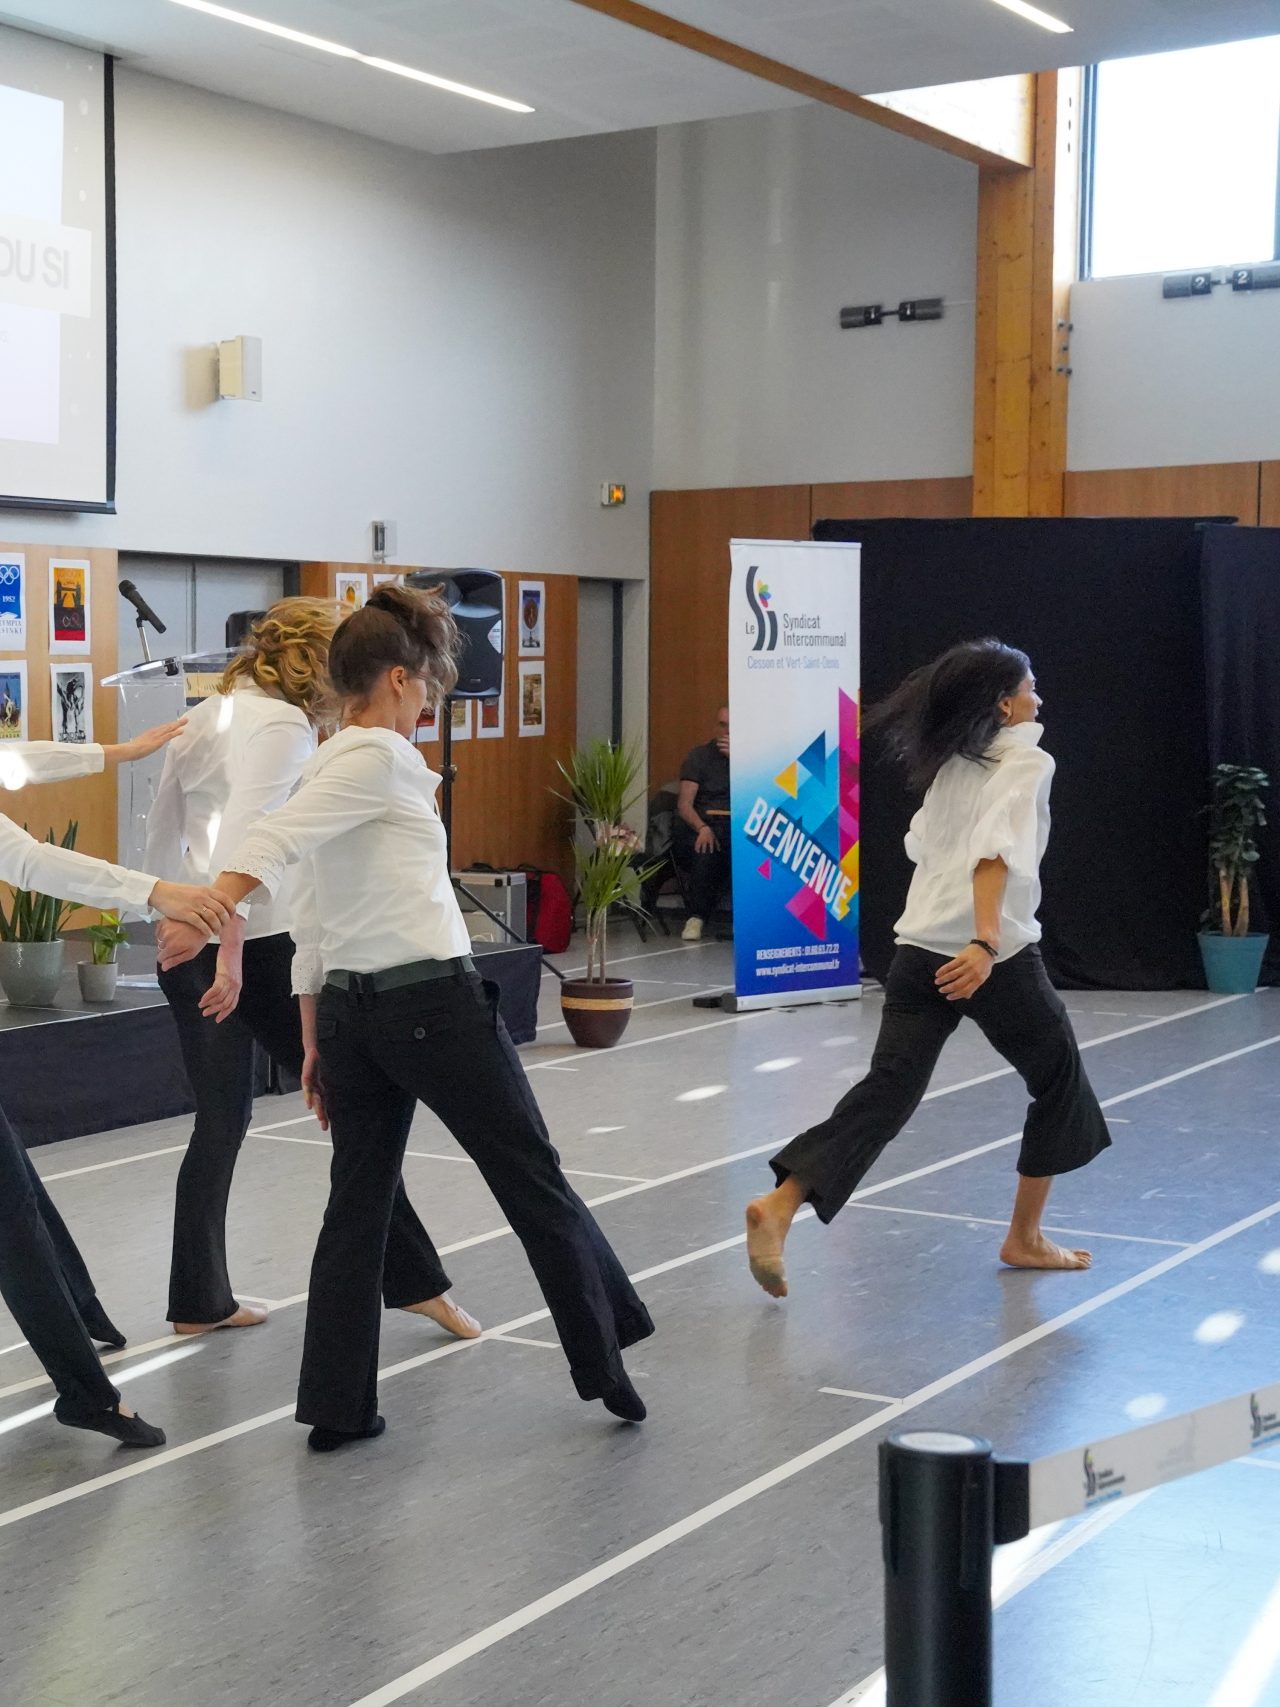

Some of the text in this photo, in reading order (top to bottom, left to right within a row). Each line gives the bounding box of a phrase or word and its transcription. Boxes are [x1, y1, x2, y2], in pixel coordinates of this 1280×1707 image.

[42, 245, 70, 290] SI
[1238, 270, 1248, 284] 2
[745, 620, 755, 635] Le
[783, 613, 821, 631] Syndicat
[783, 631, 847, 647] Intercommunal
[747, 656, 840, 669] Cesson et Vert-Saint-Denis
[743, 796, 852, 917] BIENVENUE
